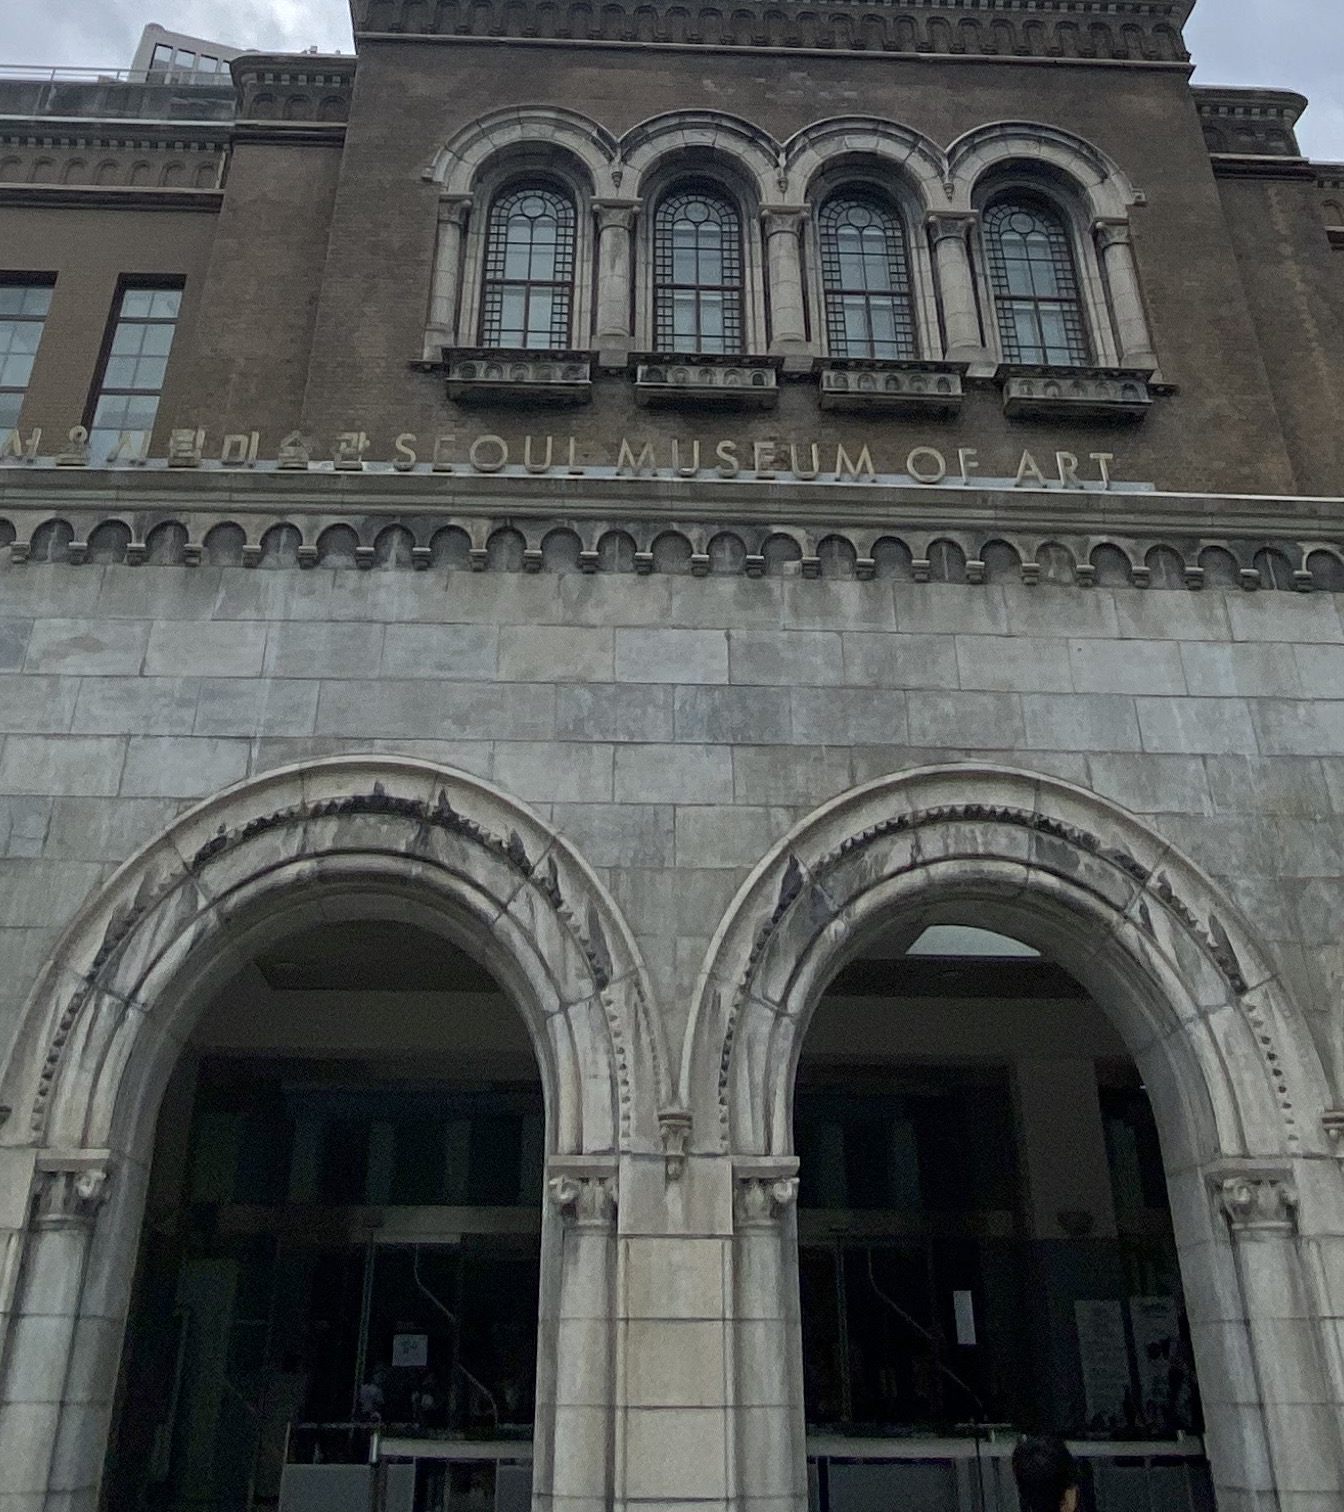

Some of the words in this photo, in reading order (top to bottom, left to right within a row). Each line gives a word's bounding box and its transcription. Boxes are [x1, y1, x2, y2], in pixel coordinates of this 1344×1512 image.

[393, 433, 583, 475] SEOUL
[616, 437, 876, 484] MUSEUM
[906, 446, 979, 486] OF
[1015, 449, 1113, 490] ART
